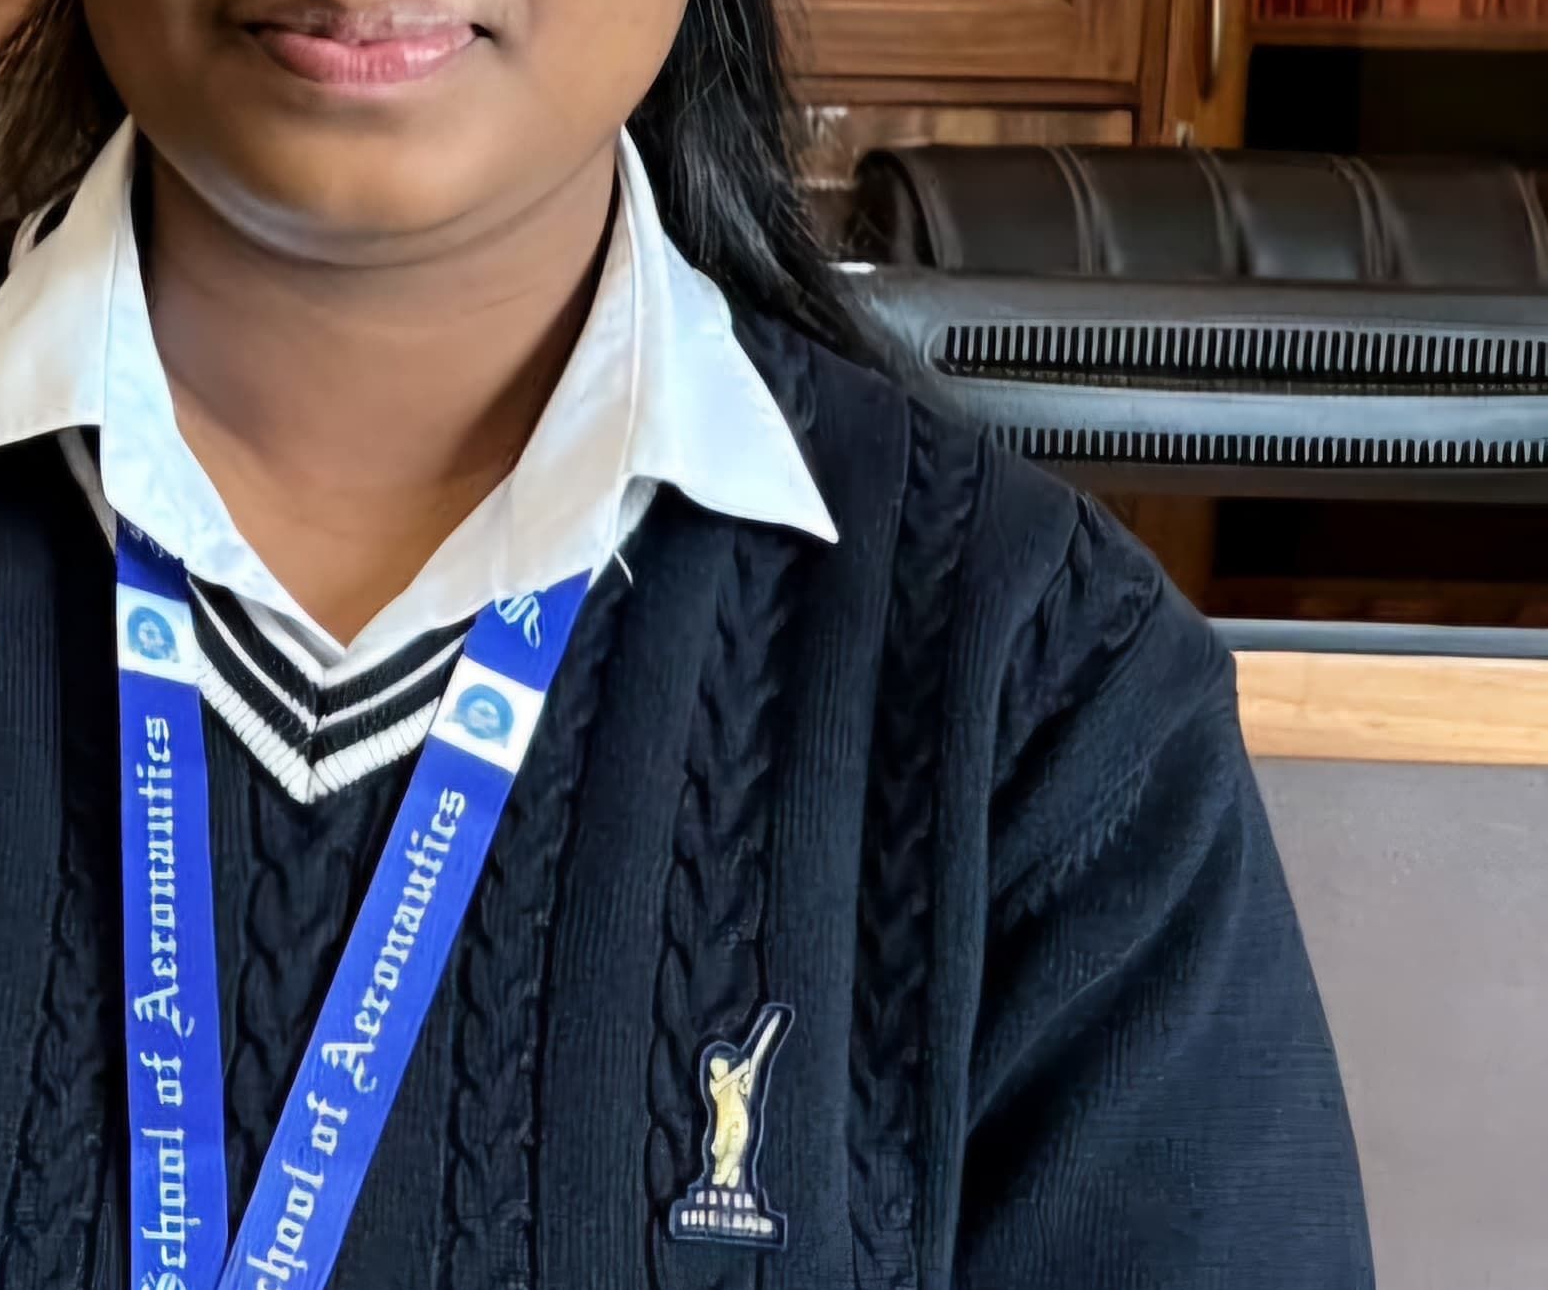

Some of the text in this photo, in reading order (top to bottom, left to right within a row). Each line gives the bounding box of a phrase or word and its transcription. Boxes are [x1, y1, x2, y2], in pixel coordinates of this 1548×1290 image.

[133, 715, 195, 1038] Aeronautics
[320, 787, 467, 1095] Aeronautics
[140, 1050, 183, 1107] of
[306, 1090, 348, 1157] of
